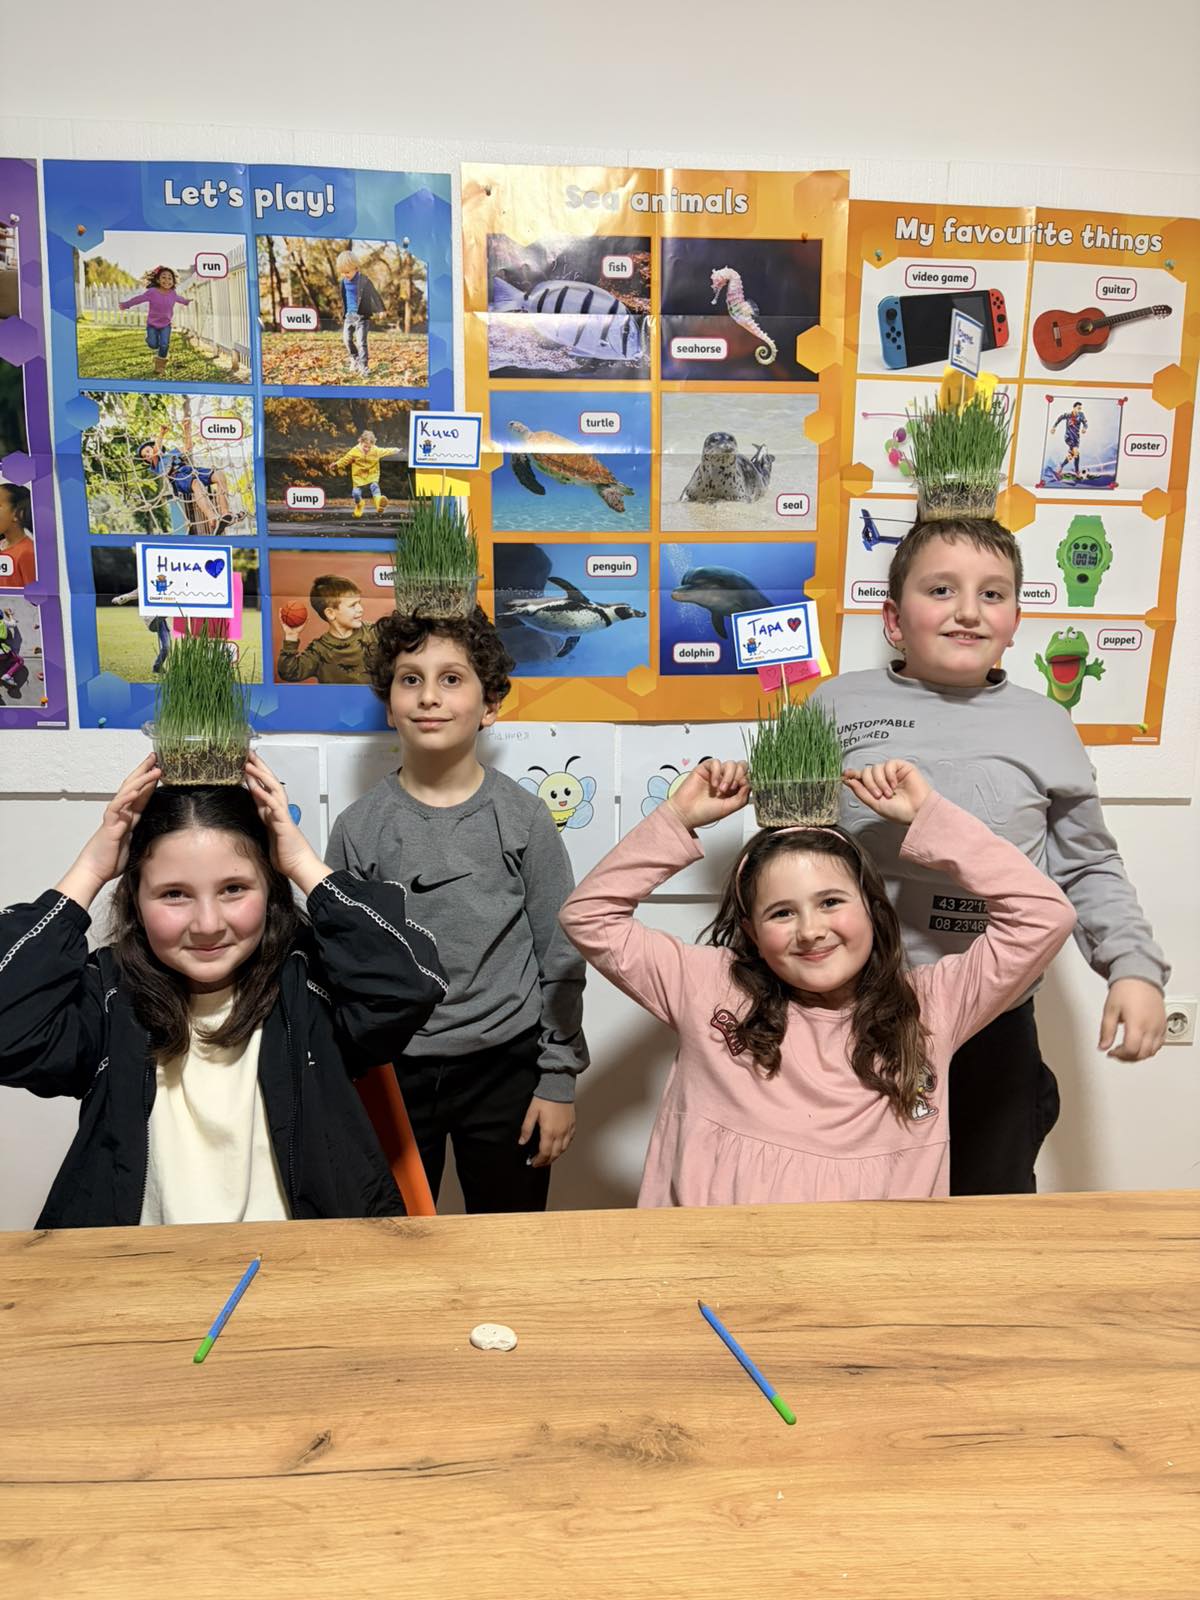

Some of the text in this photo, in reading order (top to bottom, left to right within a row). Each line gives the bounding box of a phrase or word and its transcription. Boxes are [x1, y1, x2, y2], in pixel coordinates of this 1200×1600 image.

[163, 179, 336, 219] Let's play!
[565, 185, 750, 216] Sea animals
[895, 216, 1164, 254] My favourite things
[202, 262, 221, 271] run
[608, 261, 627, 274] fish
[911, 271, 969, 287] video game
[1101, 284, 1131, 297] guitar
[286, 313, 312, 325] walk
[676, 343, 722, 356] seahorse
[207, 423, 237, 435] climb
[586, 417, 615, 428] turtle
[1130, 442, 1161, 453] poster
[291, 493, 320, 506] jump
[782, 499, 803, 510] seal
[592, 562, 632, 576] penguin
[1022, 588, 1051, 599] watch
[1102, 633, 1136, 647] puppet
[678, 648, 715, 662] dolphin
[836, 718, 917, 735] UNSTOPPABLE
[938, 898, 956, 911] 43
[935, 917, 951, 930] 08
